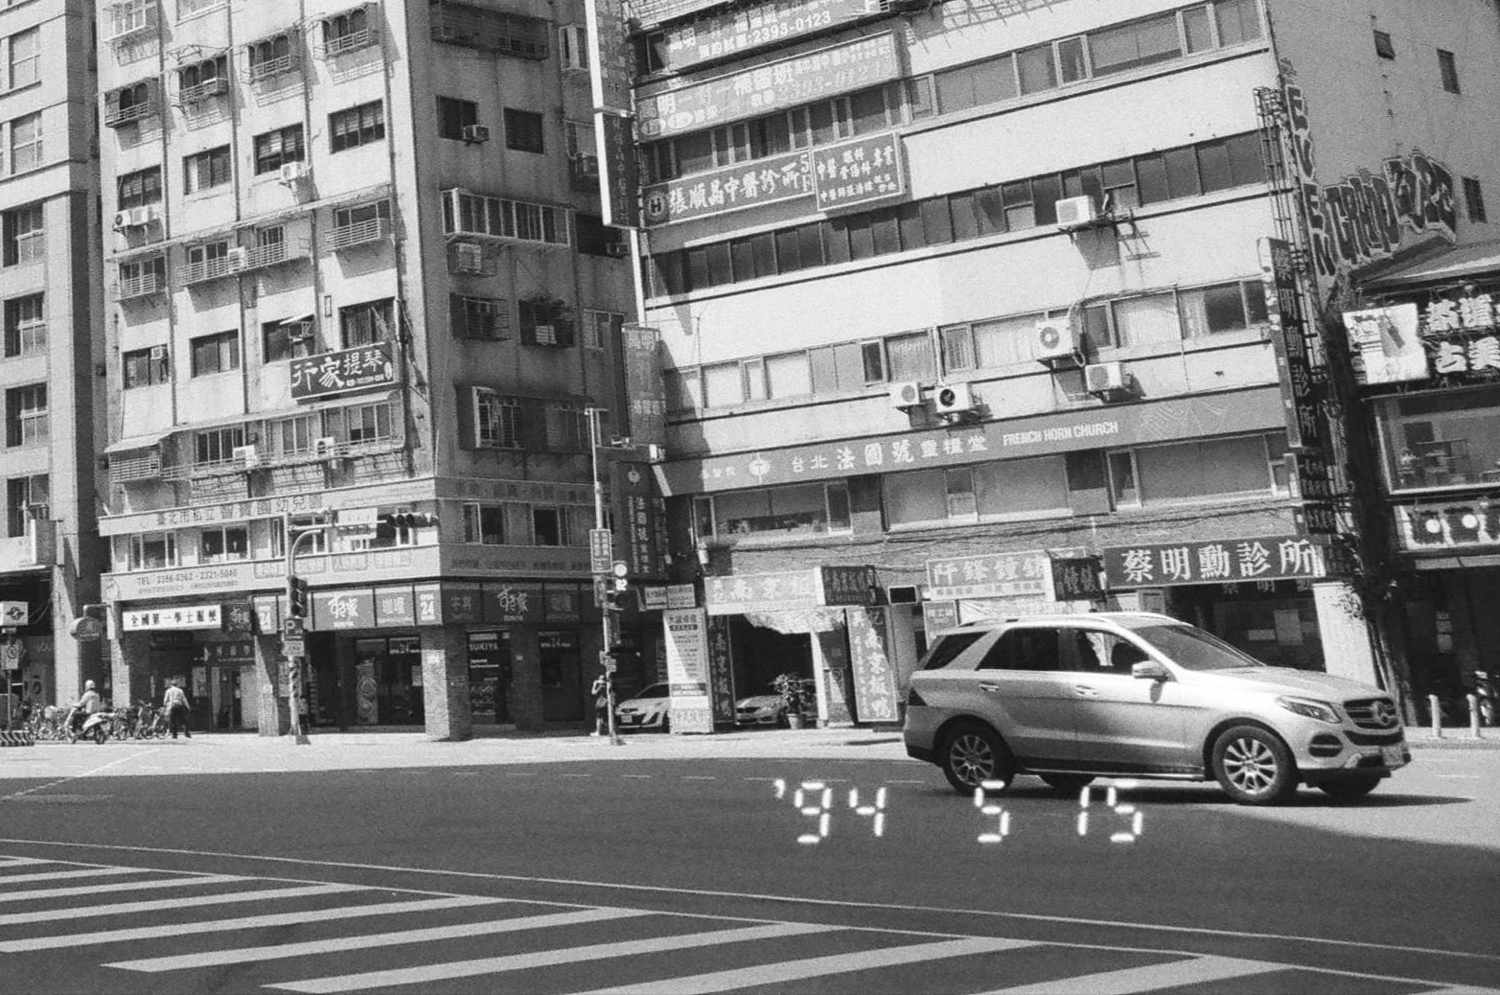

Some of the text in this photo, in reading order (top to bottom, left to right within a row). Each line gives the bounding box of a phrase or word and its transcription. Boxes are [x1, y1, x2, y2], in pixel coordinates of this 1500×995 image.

[292, 349, 383, 391] 行家提琴
[1003, 421, 1118, 446] FRENCH HORN CHURCH
[1120, 538, 1316, 583] 蔡明勳診所
[420, 601, 435, 615] 24
